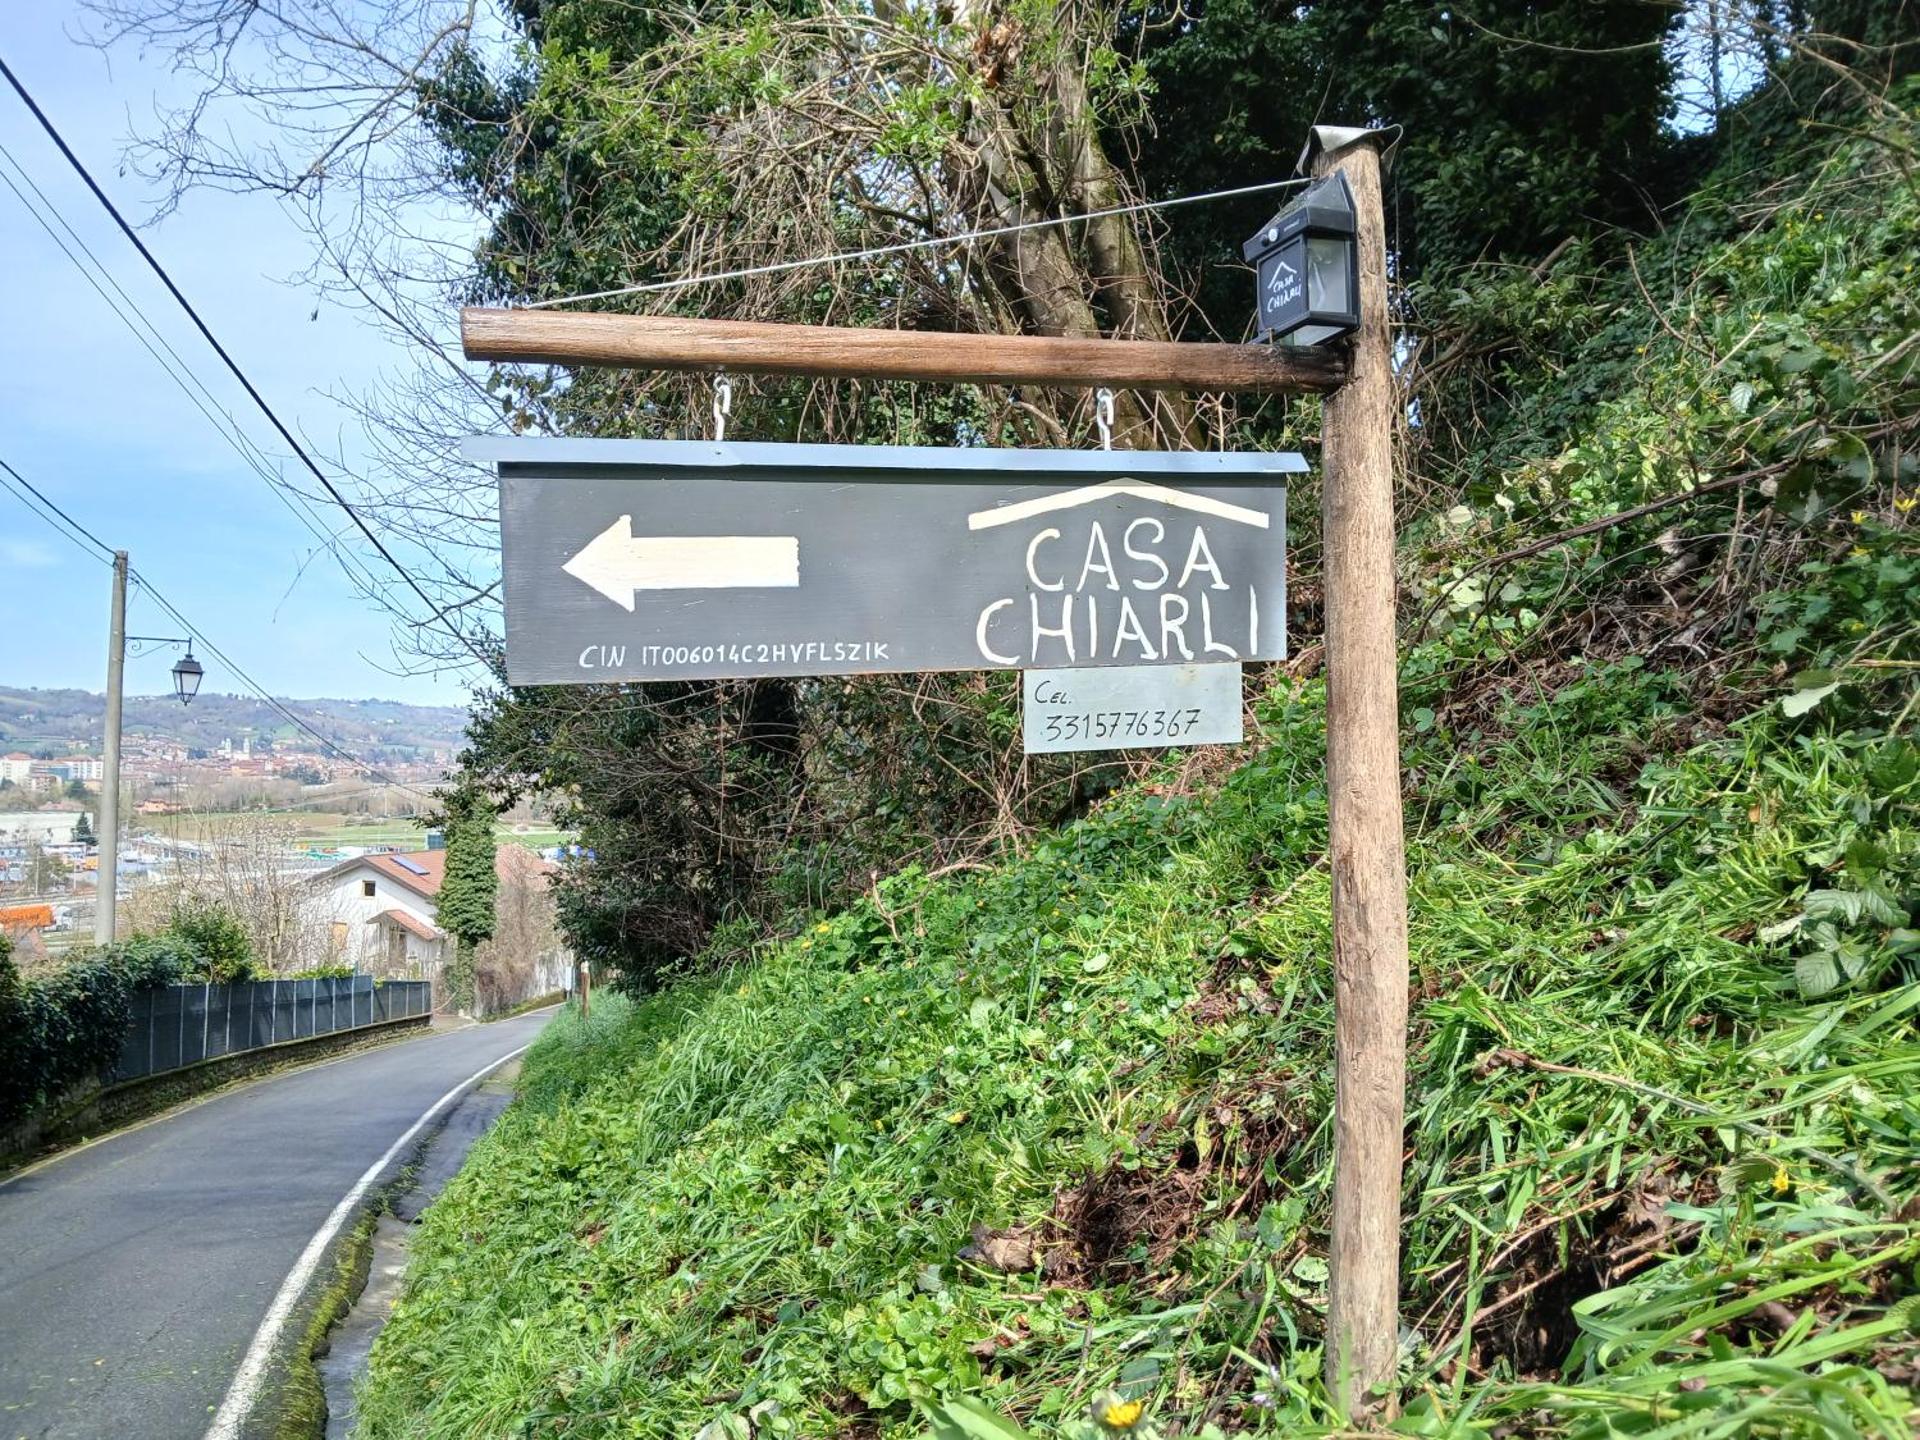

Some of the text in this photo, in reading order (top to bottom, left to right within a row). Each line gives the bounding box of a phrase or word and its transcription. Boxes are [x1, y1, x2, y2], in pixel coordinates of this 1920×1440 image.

[1026, 517, 1230, 592] CASA
[976, 584, 1258, 665] CHIARLI
[579, 645, 626, 668] CIN
[1046, 709, 1201, 742] 3315776367
